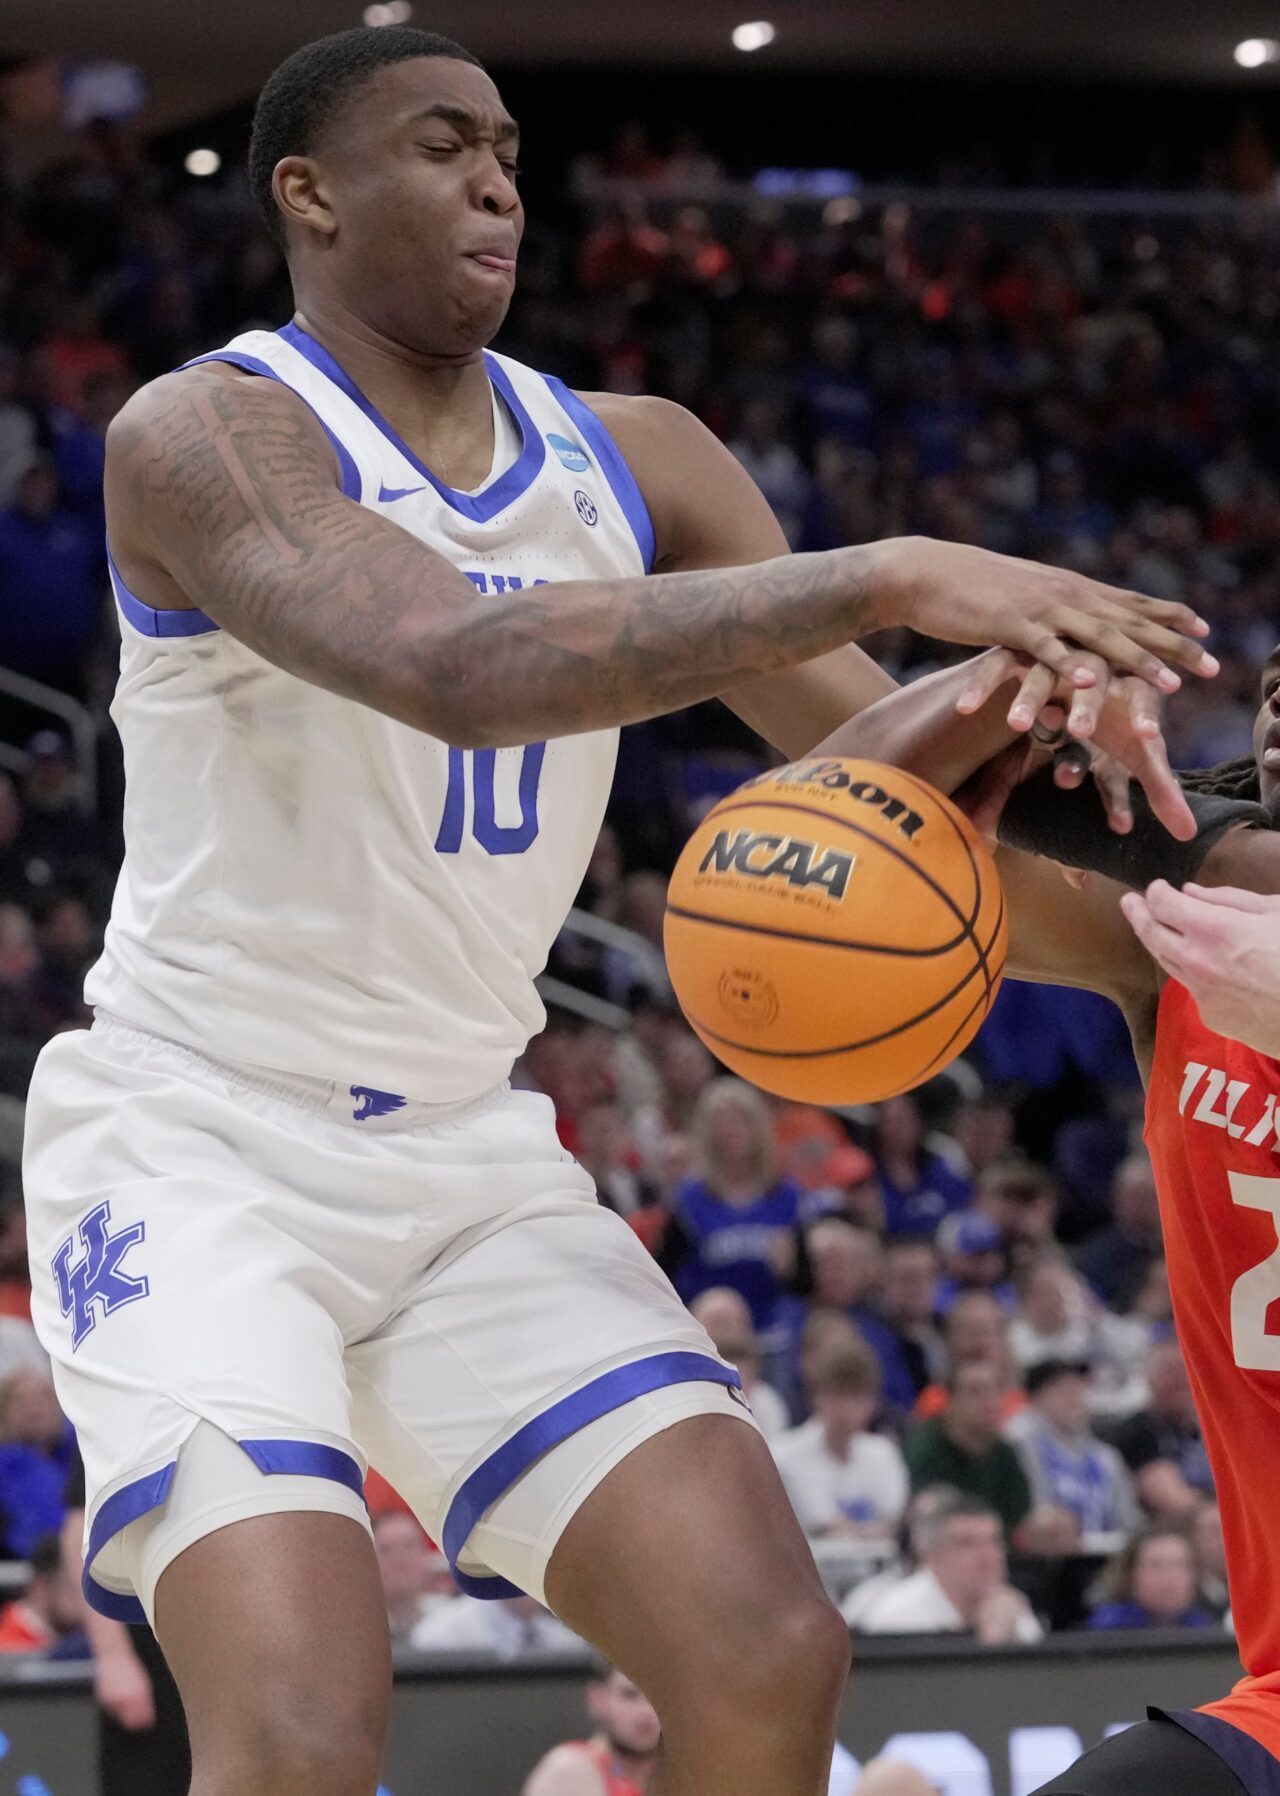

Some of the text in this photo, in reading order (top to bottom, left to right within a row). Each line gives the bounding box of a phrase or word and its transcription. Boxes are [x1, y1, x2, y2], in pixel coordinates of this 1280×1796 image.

[434, 740, 547, 855] 10
[738, 762, 925, 841] ilson
[698, 828, 857, 904] NCAA
